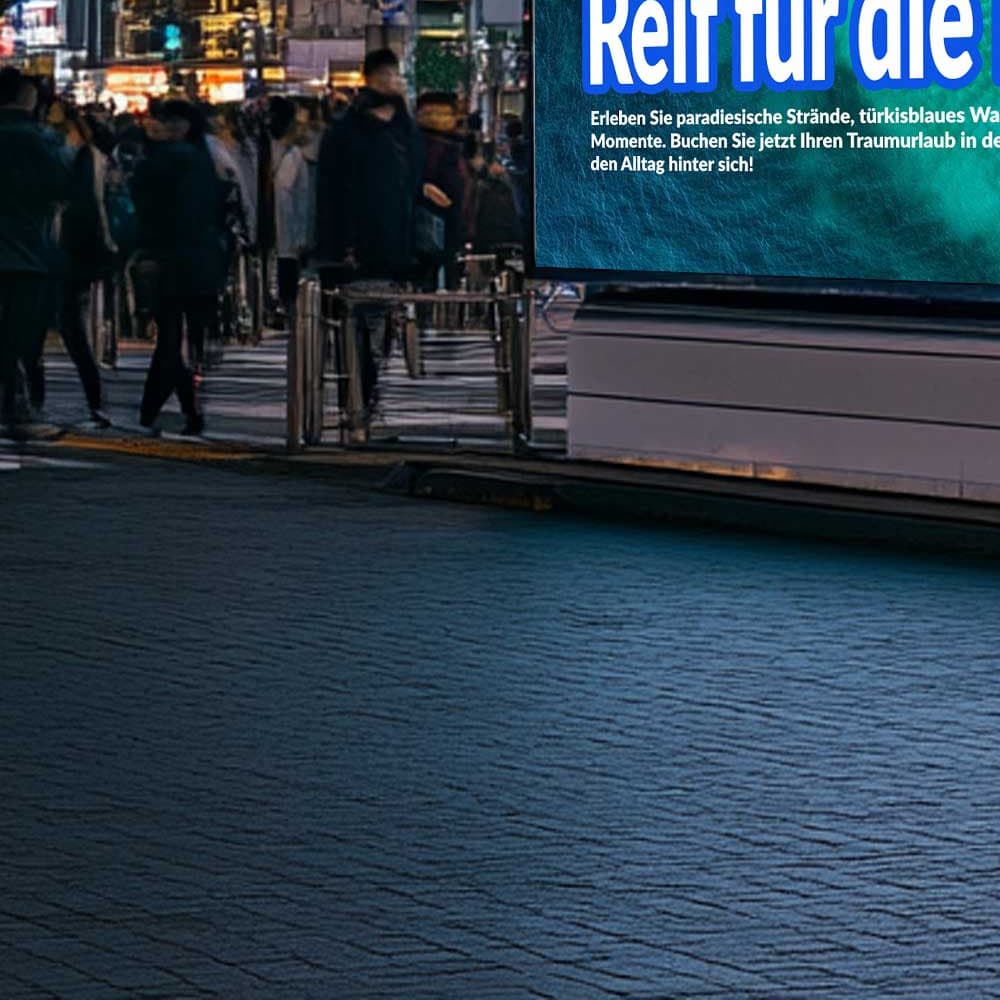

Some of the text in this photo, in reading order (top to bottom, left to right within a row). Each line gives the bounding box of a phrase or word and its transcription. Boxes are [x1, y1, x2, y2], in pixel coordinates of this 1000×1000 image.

[590, 109, 646, 126] Erleben
[649, 109, 673, 126] Sie
[676, 108, 783, 128] paradiesische
[786, 107, 855, 127] Strände,
[859, 106, 965, 125] türkisblaues
[590, 133, 666, 149] Momente.
[670, 132, 728, 149] Buchen
[731, 132, 756, 149] Sie
[758, 132, 796, 152] jetzt
[800, 132, 843, 149] Ihren
[846, 131, 956, 149] Traumurlaub
[960, 131, 977, 149] in
[590, 155, 754, 175] den Alltag hinter sich!
